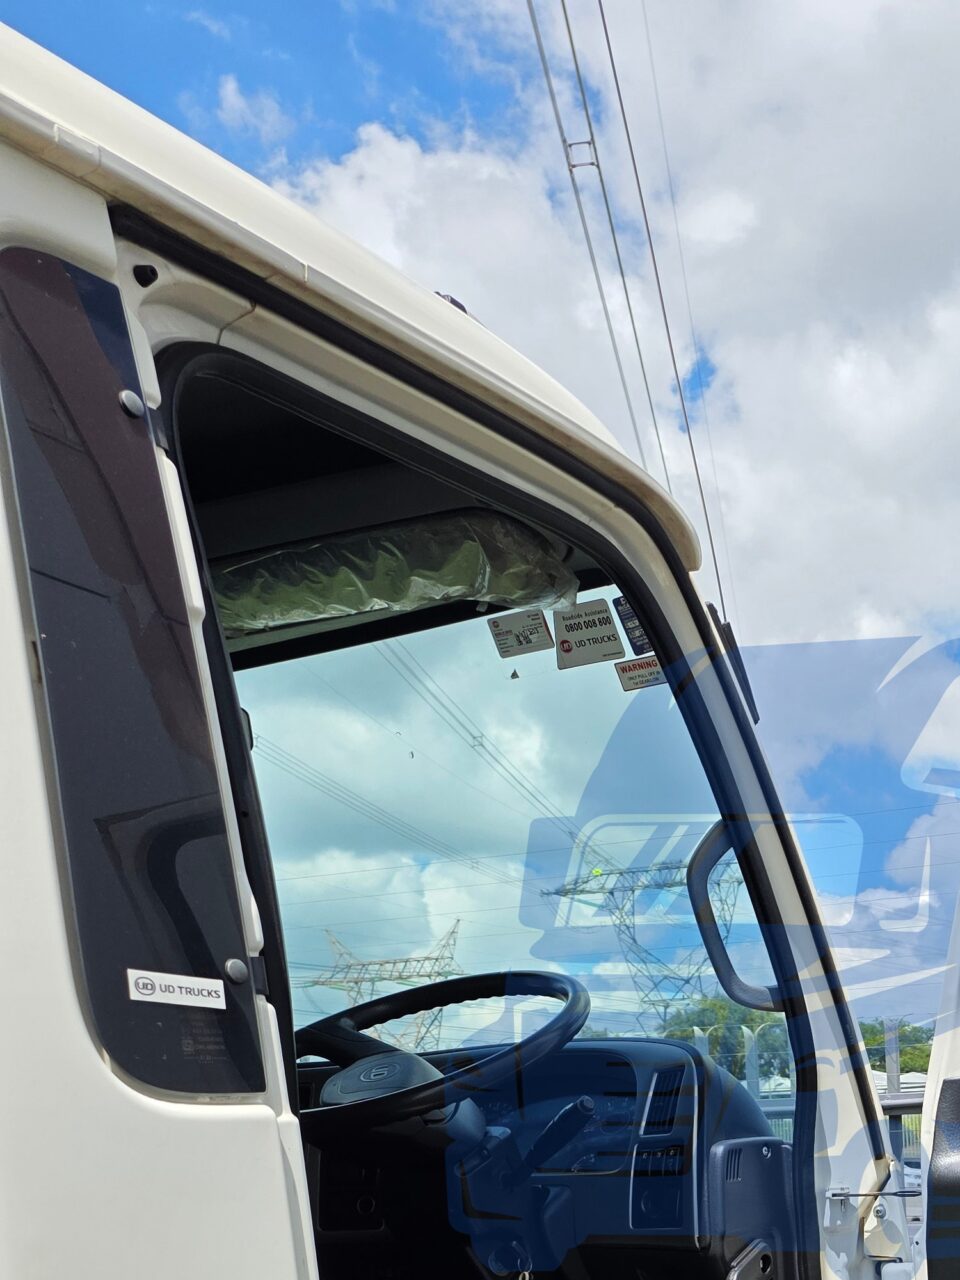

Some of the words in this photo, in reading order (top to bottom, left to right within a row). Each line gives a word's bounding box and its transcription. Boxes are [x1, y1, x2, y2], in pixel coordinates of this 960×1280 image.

[565, 622, 583, 633] 0800
[575, 640, 587, 648] UD
[587, 634, 617, 645] TRUCKS
[620, 660, 658, 674] WARNING
[159, 983, 175, 994] UD
[178, 986, 220, 998] TRUCKS
